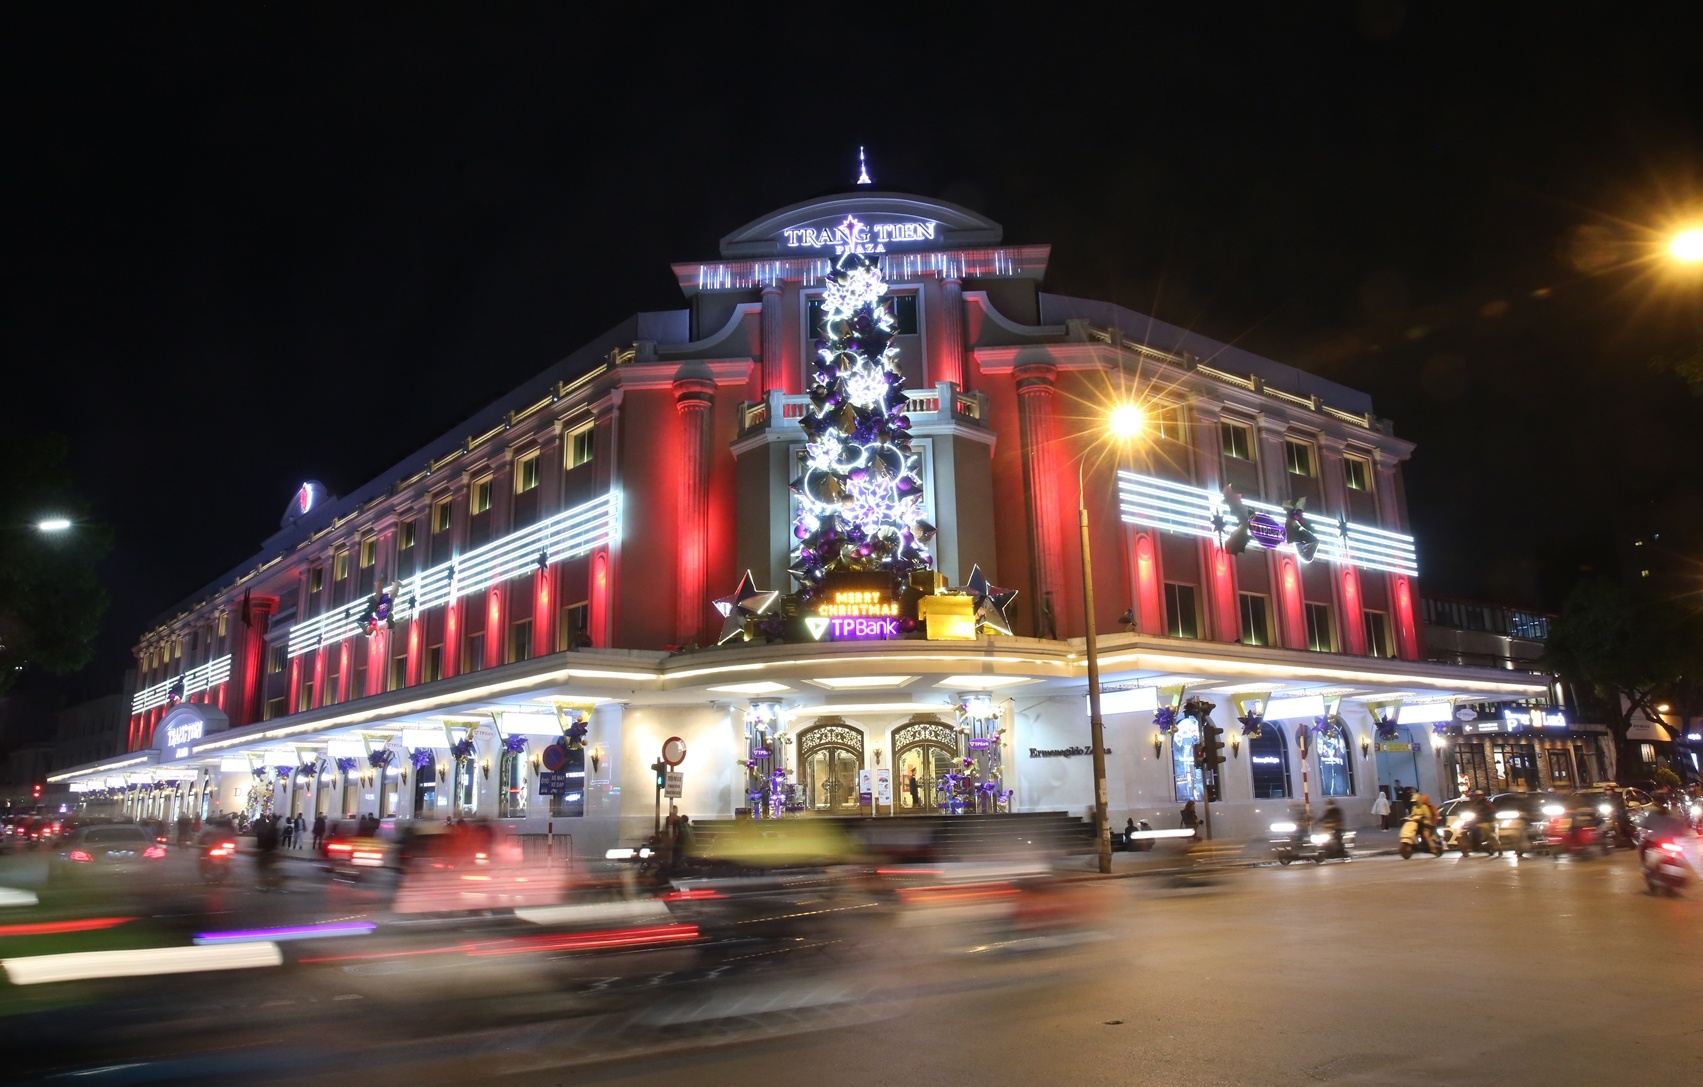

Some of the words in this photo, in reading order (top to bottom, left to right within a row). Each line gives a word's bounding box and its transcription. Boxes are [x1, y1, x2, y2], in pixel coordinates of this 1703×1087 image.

[784, 225, 871, 248] TRANG
[873, 222, 937, 242] TIEN
[835, 591, 880, 604] MERRY
[818, 603, 899, 616] CHRISTMAS
[831, 617, 898, 637] TPBank
[1028, 746, 1084, 759] Ermenegildo
